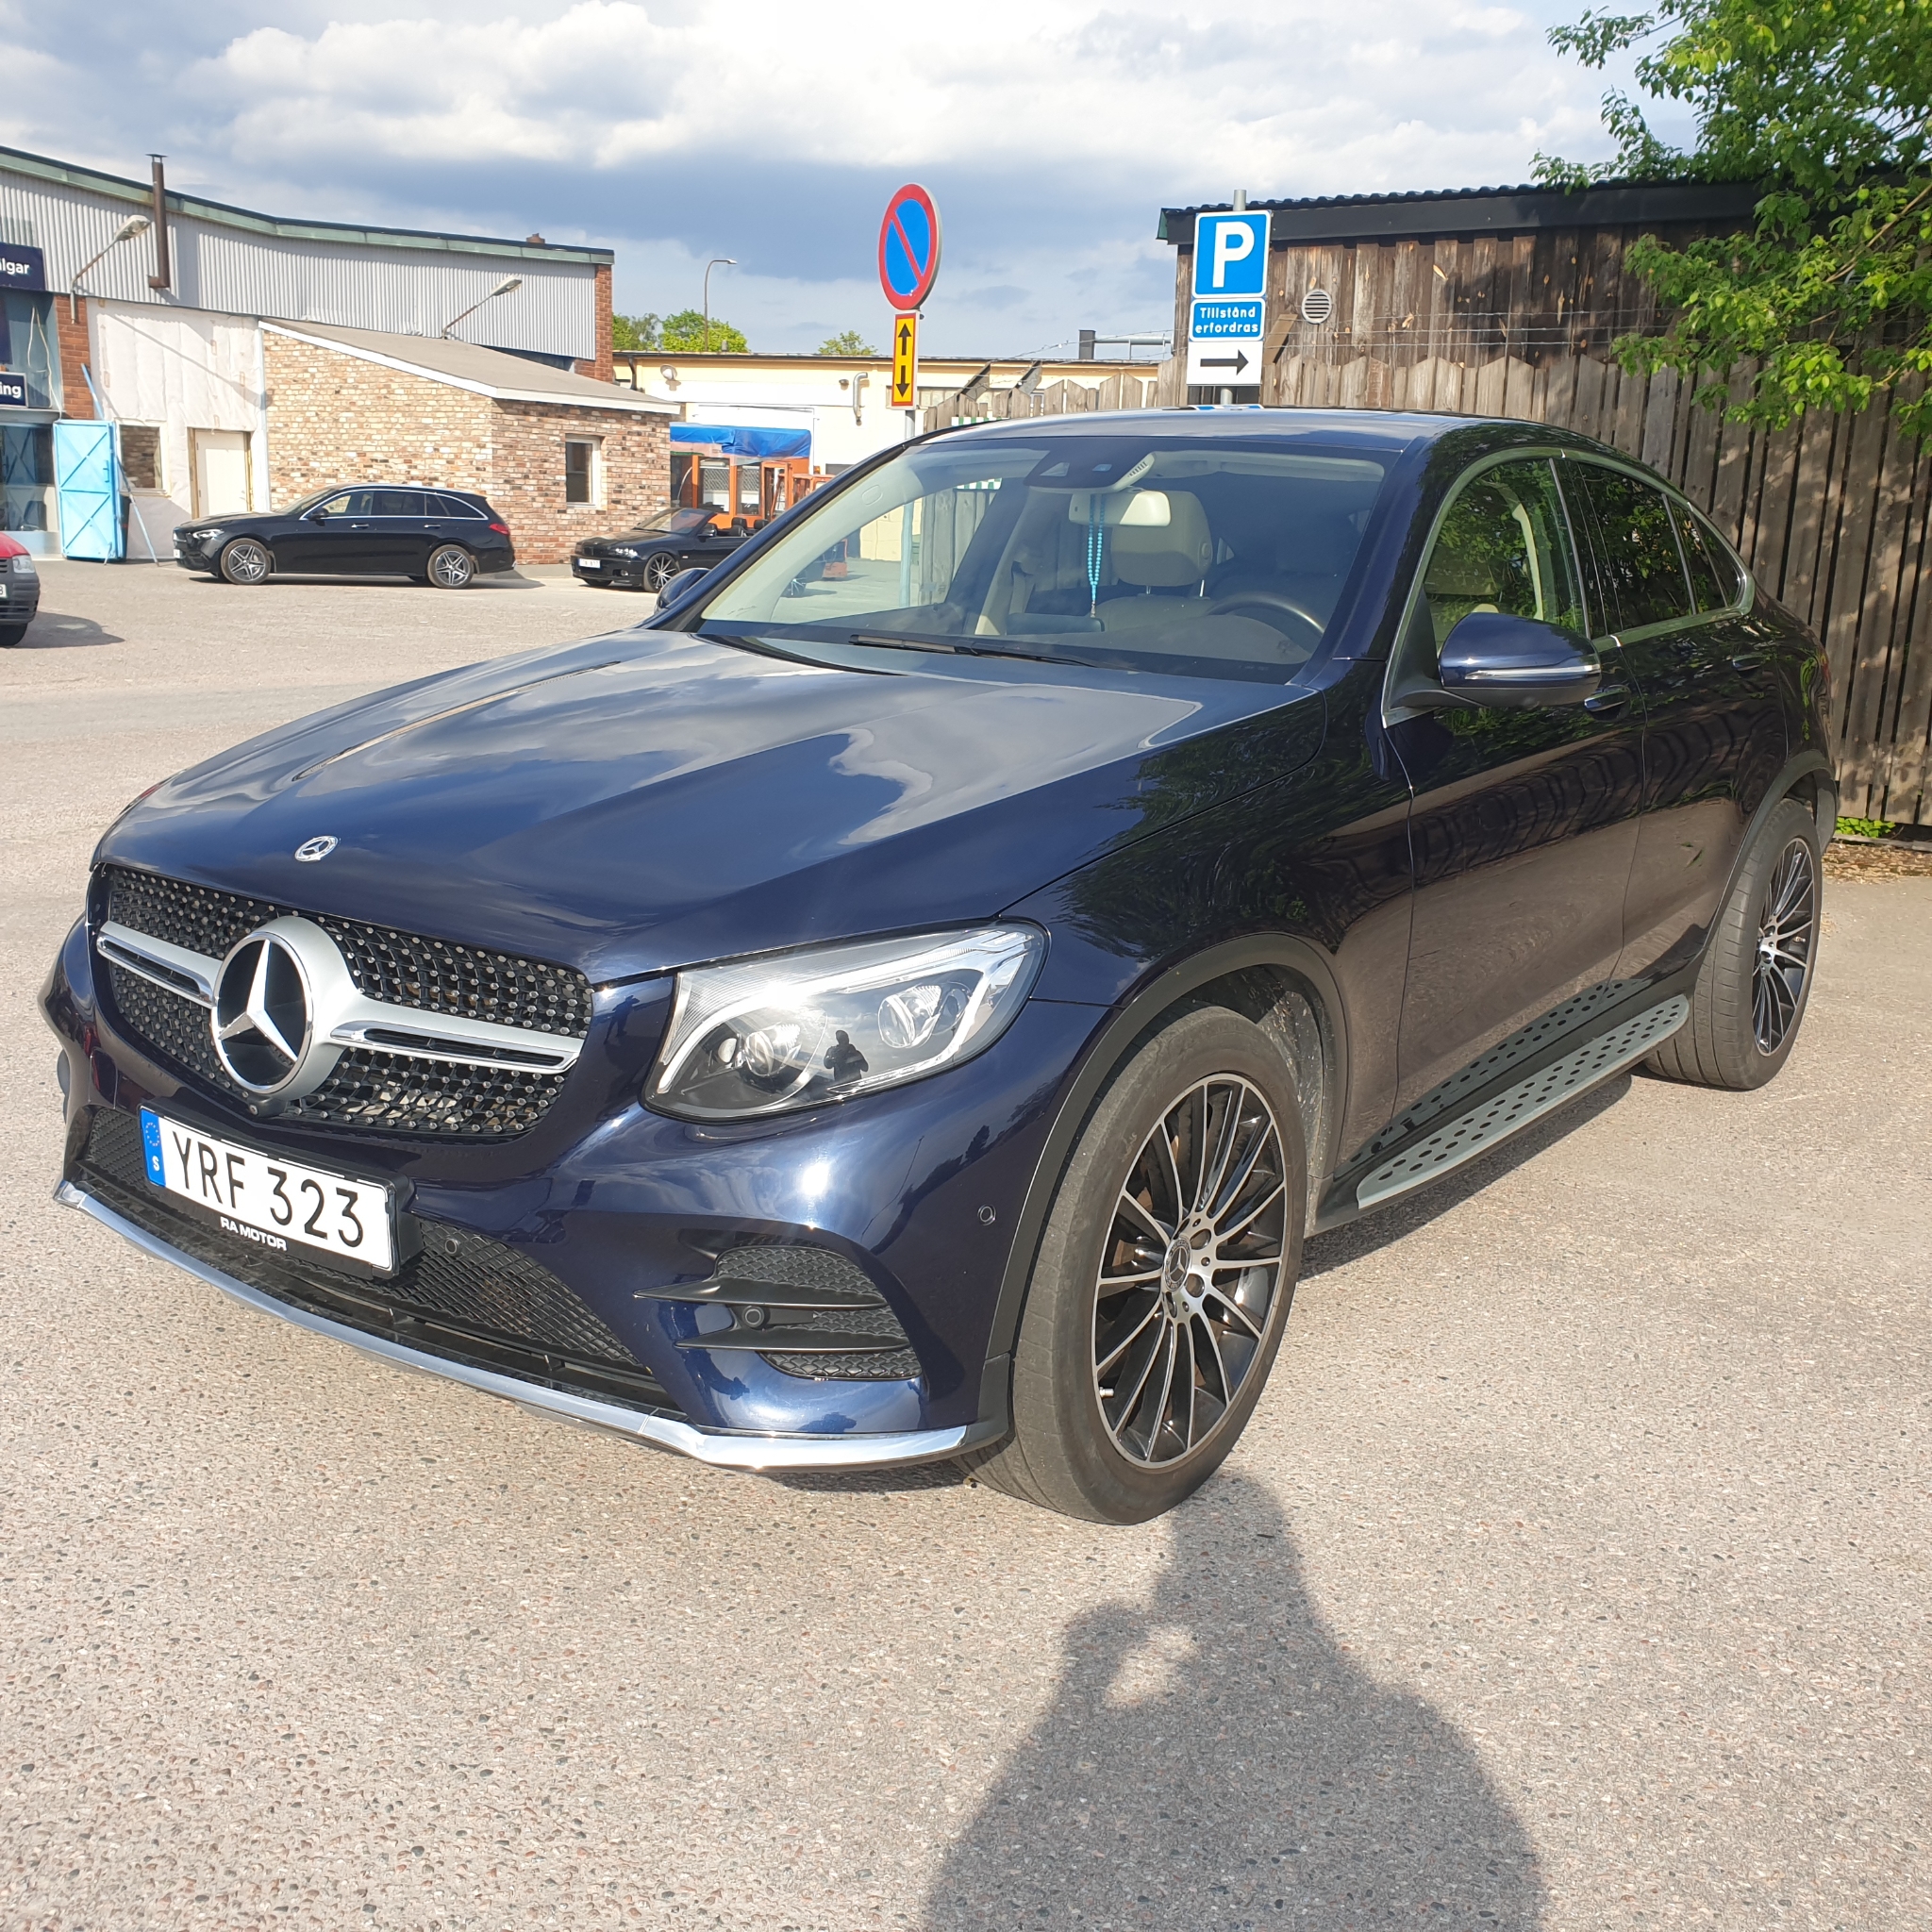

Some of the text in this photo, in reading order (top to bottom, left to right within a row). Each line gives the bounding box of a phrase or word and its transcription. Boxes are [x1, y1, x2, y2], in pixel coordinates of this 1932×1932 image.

[1212, 221, 1255, 288] P
[1200, 306, 1256, 319] Tillstånd
[1194, 322, 1258, 334] erfordras
[152, 1155, 160, 1172] S
[173, 1130, 364, 1247] YRF 323
[220, 1216, 287, 1252] RA MOTOR
